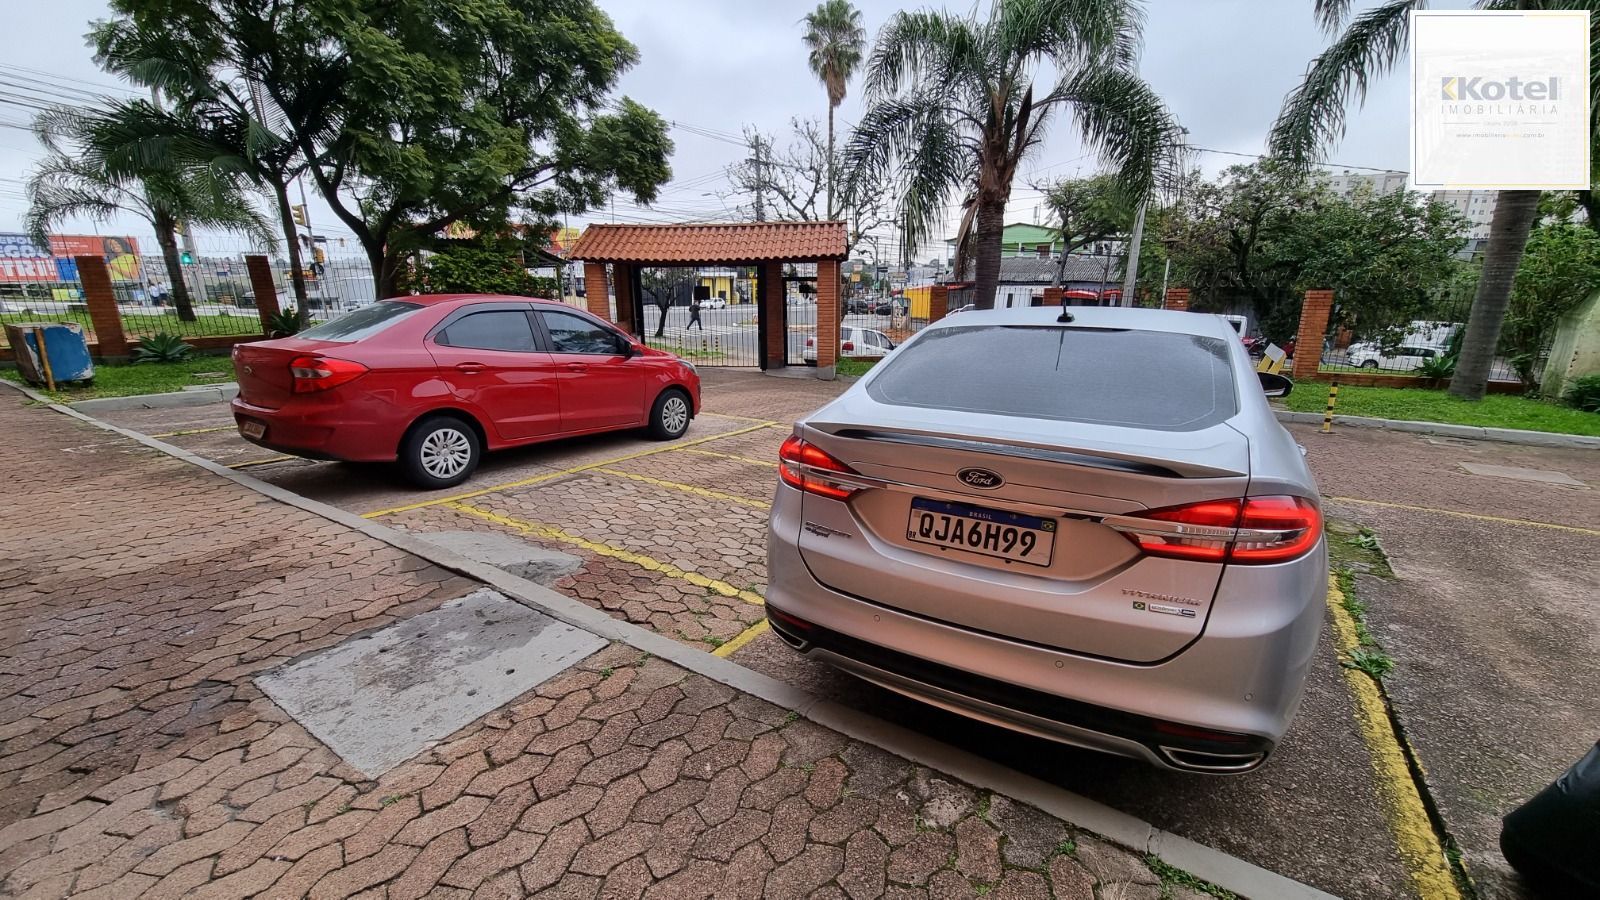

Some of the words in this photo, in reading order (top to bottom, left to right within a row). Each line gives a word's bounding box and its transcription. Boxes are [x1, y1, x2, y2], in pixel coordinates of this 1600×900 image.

[969, 511, 993, 520] BRASIL
[908, 530, 917, 539] BR
[919, 513, 1037, 557] QJA6H99
